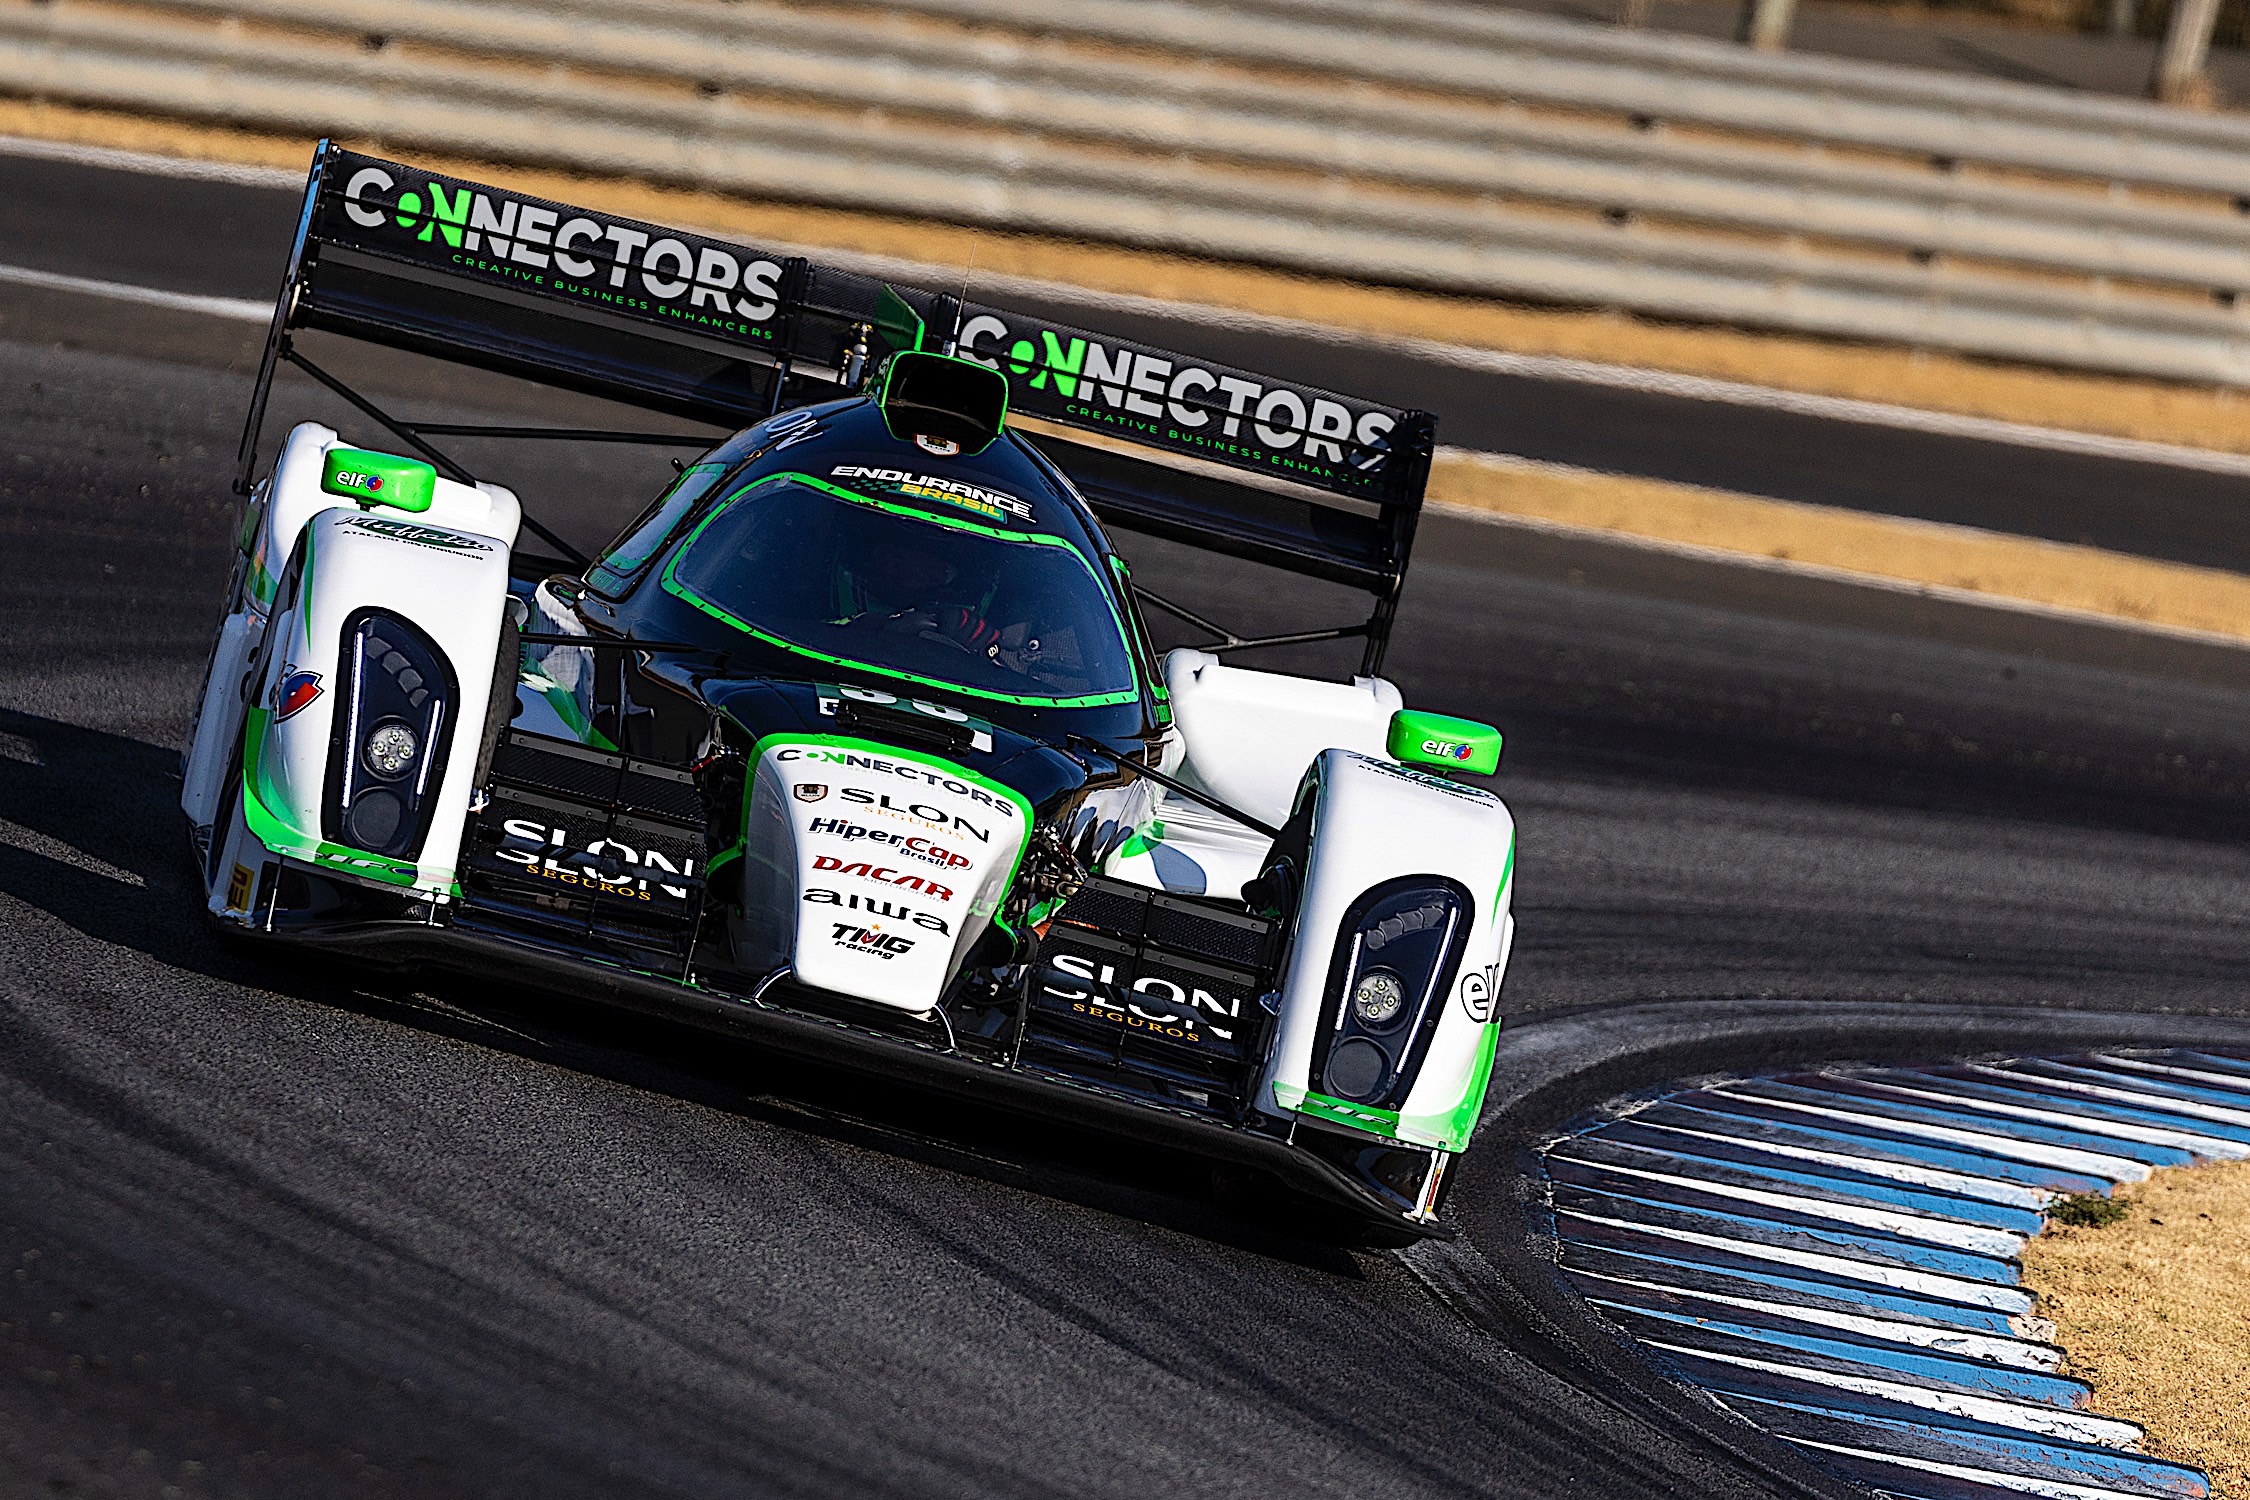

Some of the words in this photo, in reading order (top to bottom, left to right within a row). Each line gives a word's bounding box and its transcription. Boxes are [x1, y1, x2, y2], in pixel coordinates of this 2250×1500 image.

[452, 253, 546, 285] CREATIVE
[553, 279, 650, 311] BUSINESS
[658, 305, 774, 341] ENHANCERS
[1066, 404, 1160, 434] CREATIVE
[1167, 429, 1262, 461] BUSINESS
[336, 470, 368, 489] elf
[830, 465, 1034, 519] ENDURANCE
[900, 483, 1002, 518] BRASIL
[1421, 739, 1456, 757] elf
[840, 787, 990, 844] SLON
[863, 806, 965, 841] SEGUROS
[495, 819, 694, 899] SLON
[807, 817, 973, 870] HiperCap
[526, 864, 651, 901] SEGUROS
[811, 854, 955, 903] DACAR
[802, 888, 951, 938] aiwa
[832, 922, 916, 955] TMG
[834, 940, 896, 960] racing
[1043, 954, 1240, 1040] SLON
[1460, 962, 1500, 1024] el
[1072, 1003, 1199, 1042] SEGUROS
